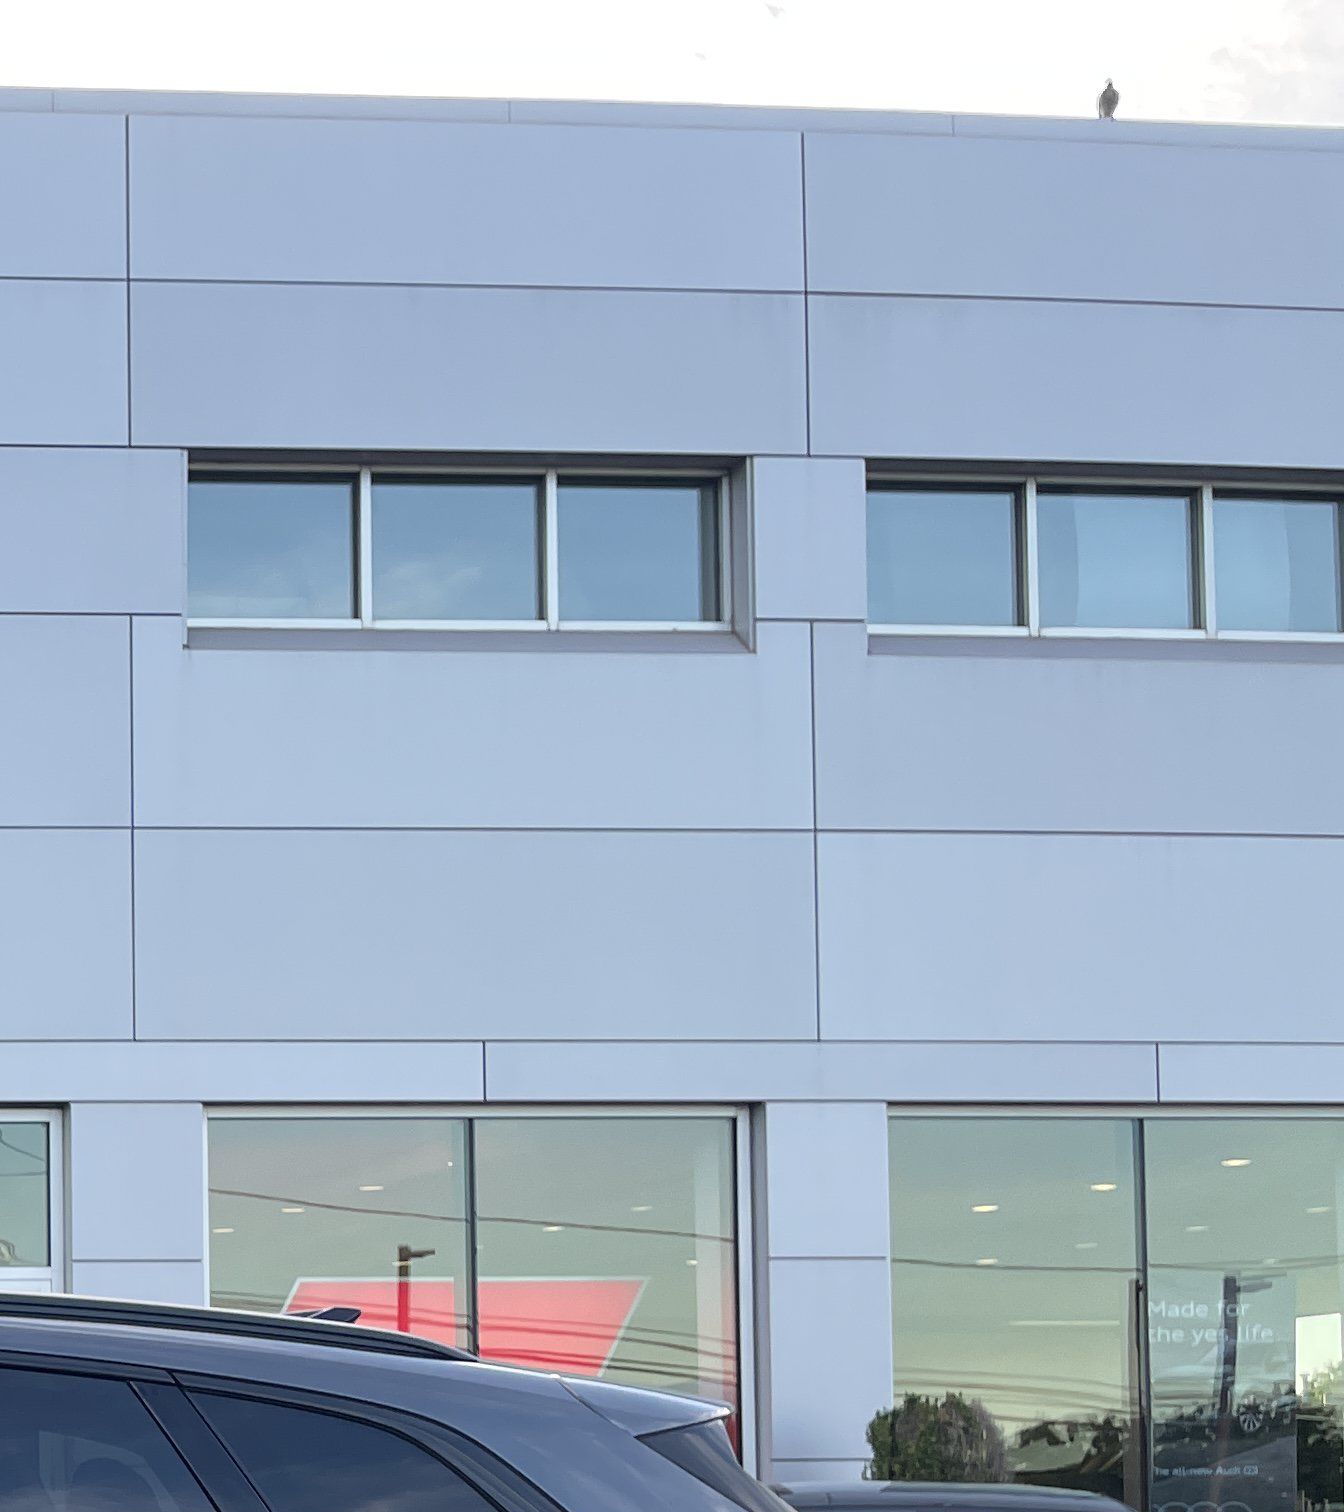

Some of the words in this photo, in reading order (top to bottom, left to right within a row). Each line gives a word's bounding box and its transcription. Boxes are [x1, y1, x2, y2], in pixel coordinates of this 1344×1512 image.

[1149, 1300, 1209, 1318] Made
[1218, 1299, 1250, 1317] for
[1149, 1326, 1185, 1343] the
[1238, 1324, 1274, 1343] life
